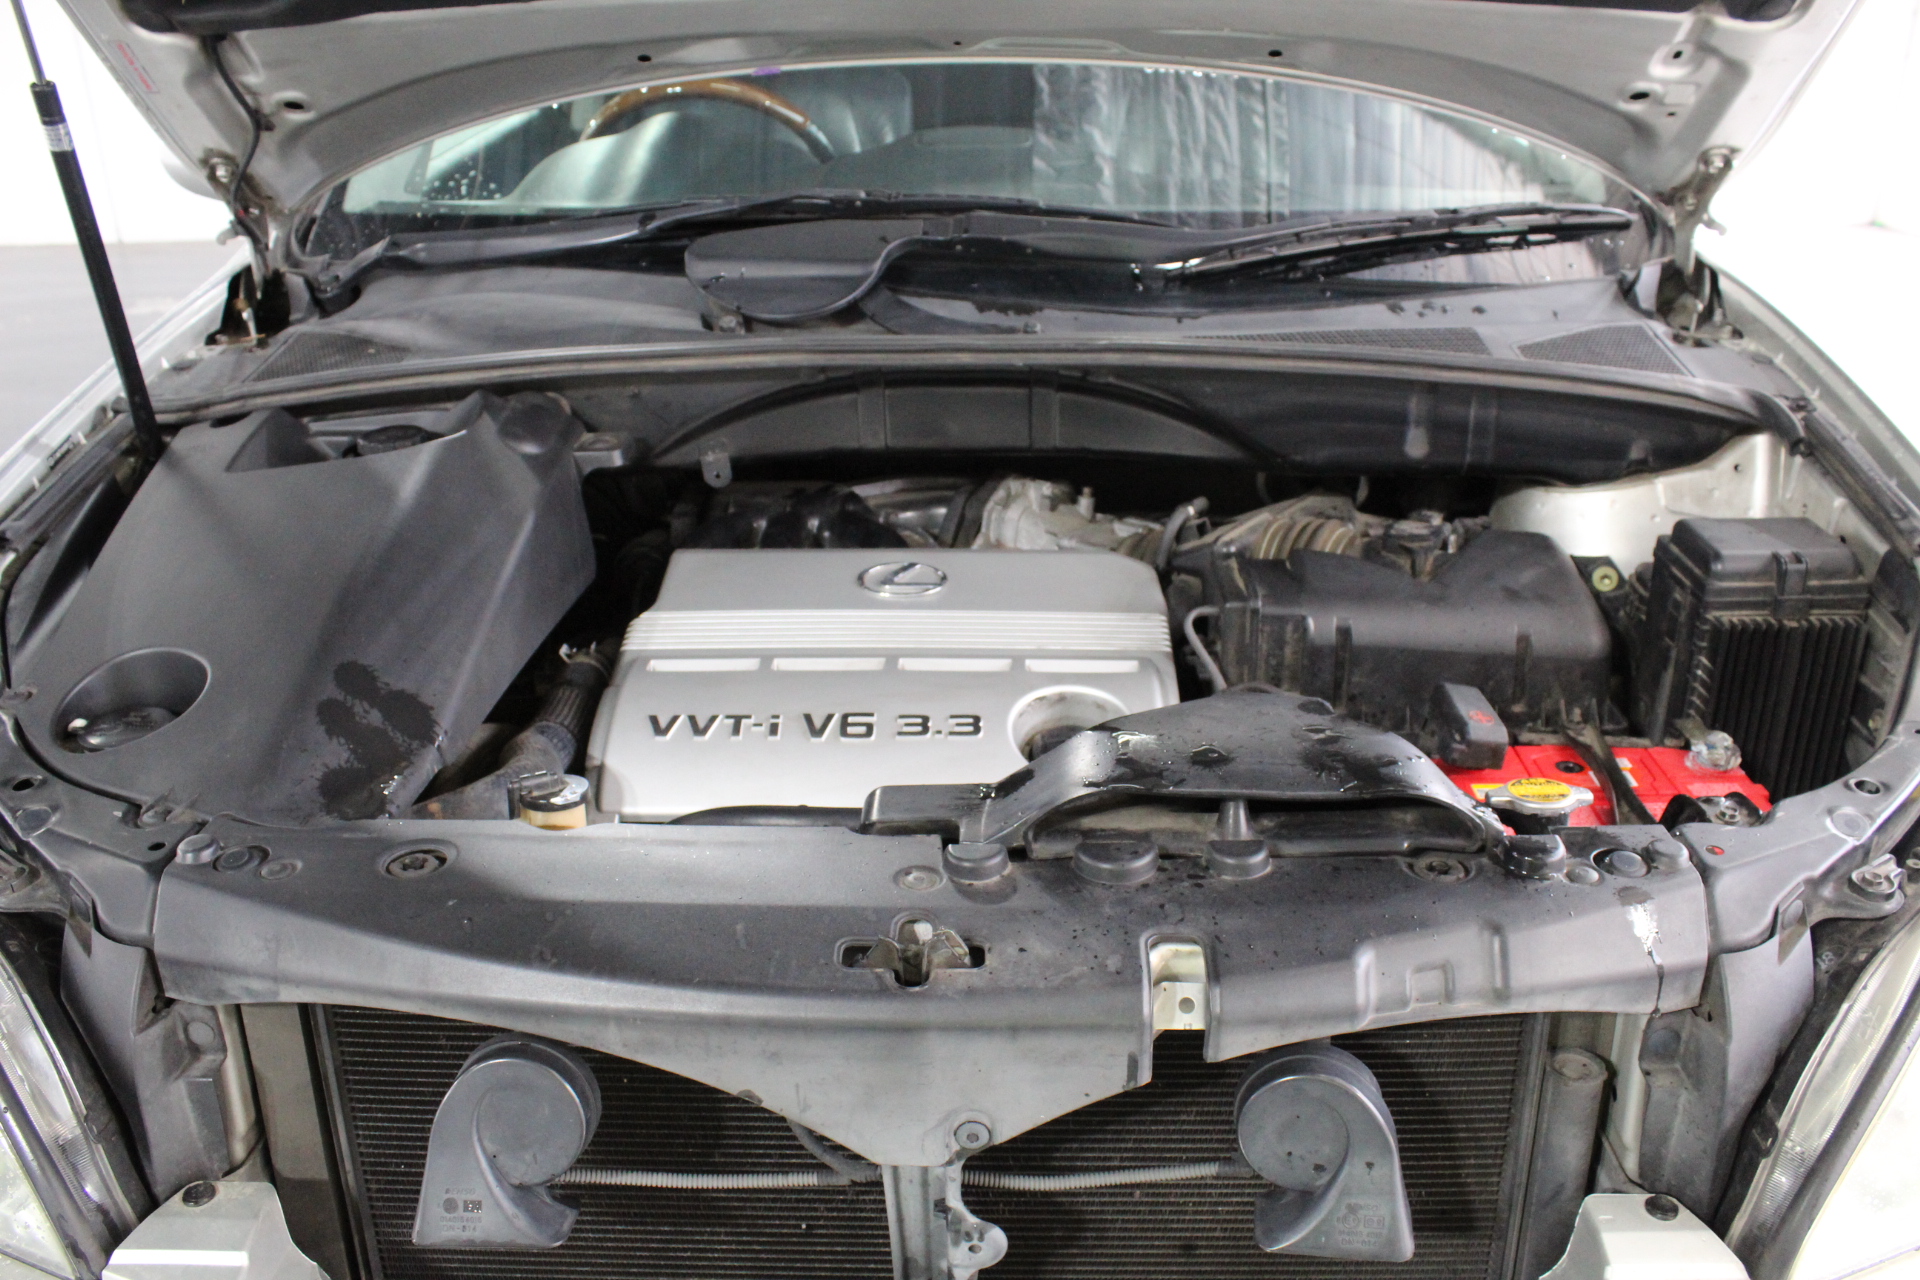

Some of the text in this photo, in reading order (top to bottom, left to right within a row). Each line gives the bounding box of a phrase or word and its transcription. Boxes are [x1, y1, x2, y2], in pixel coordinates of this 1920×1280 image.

[648, 711, 983, 740] VVT-i V6 3.3
